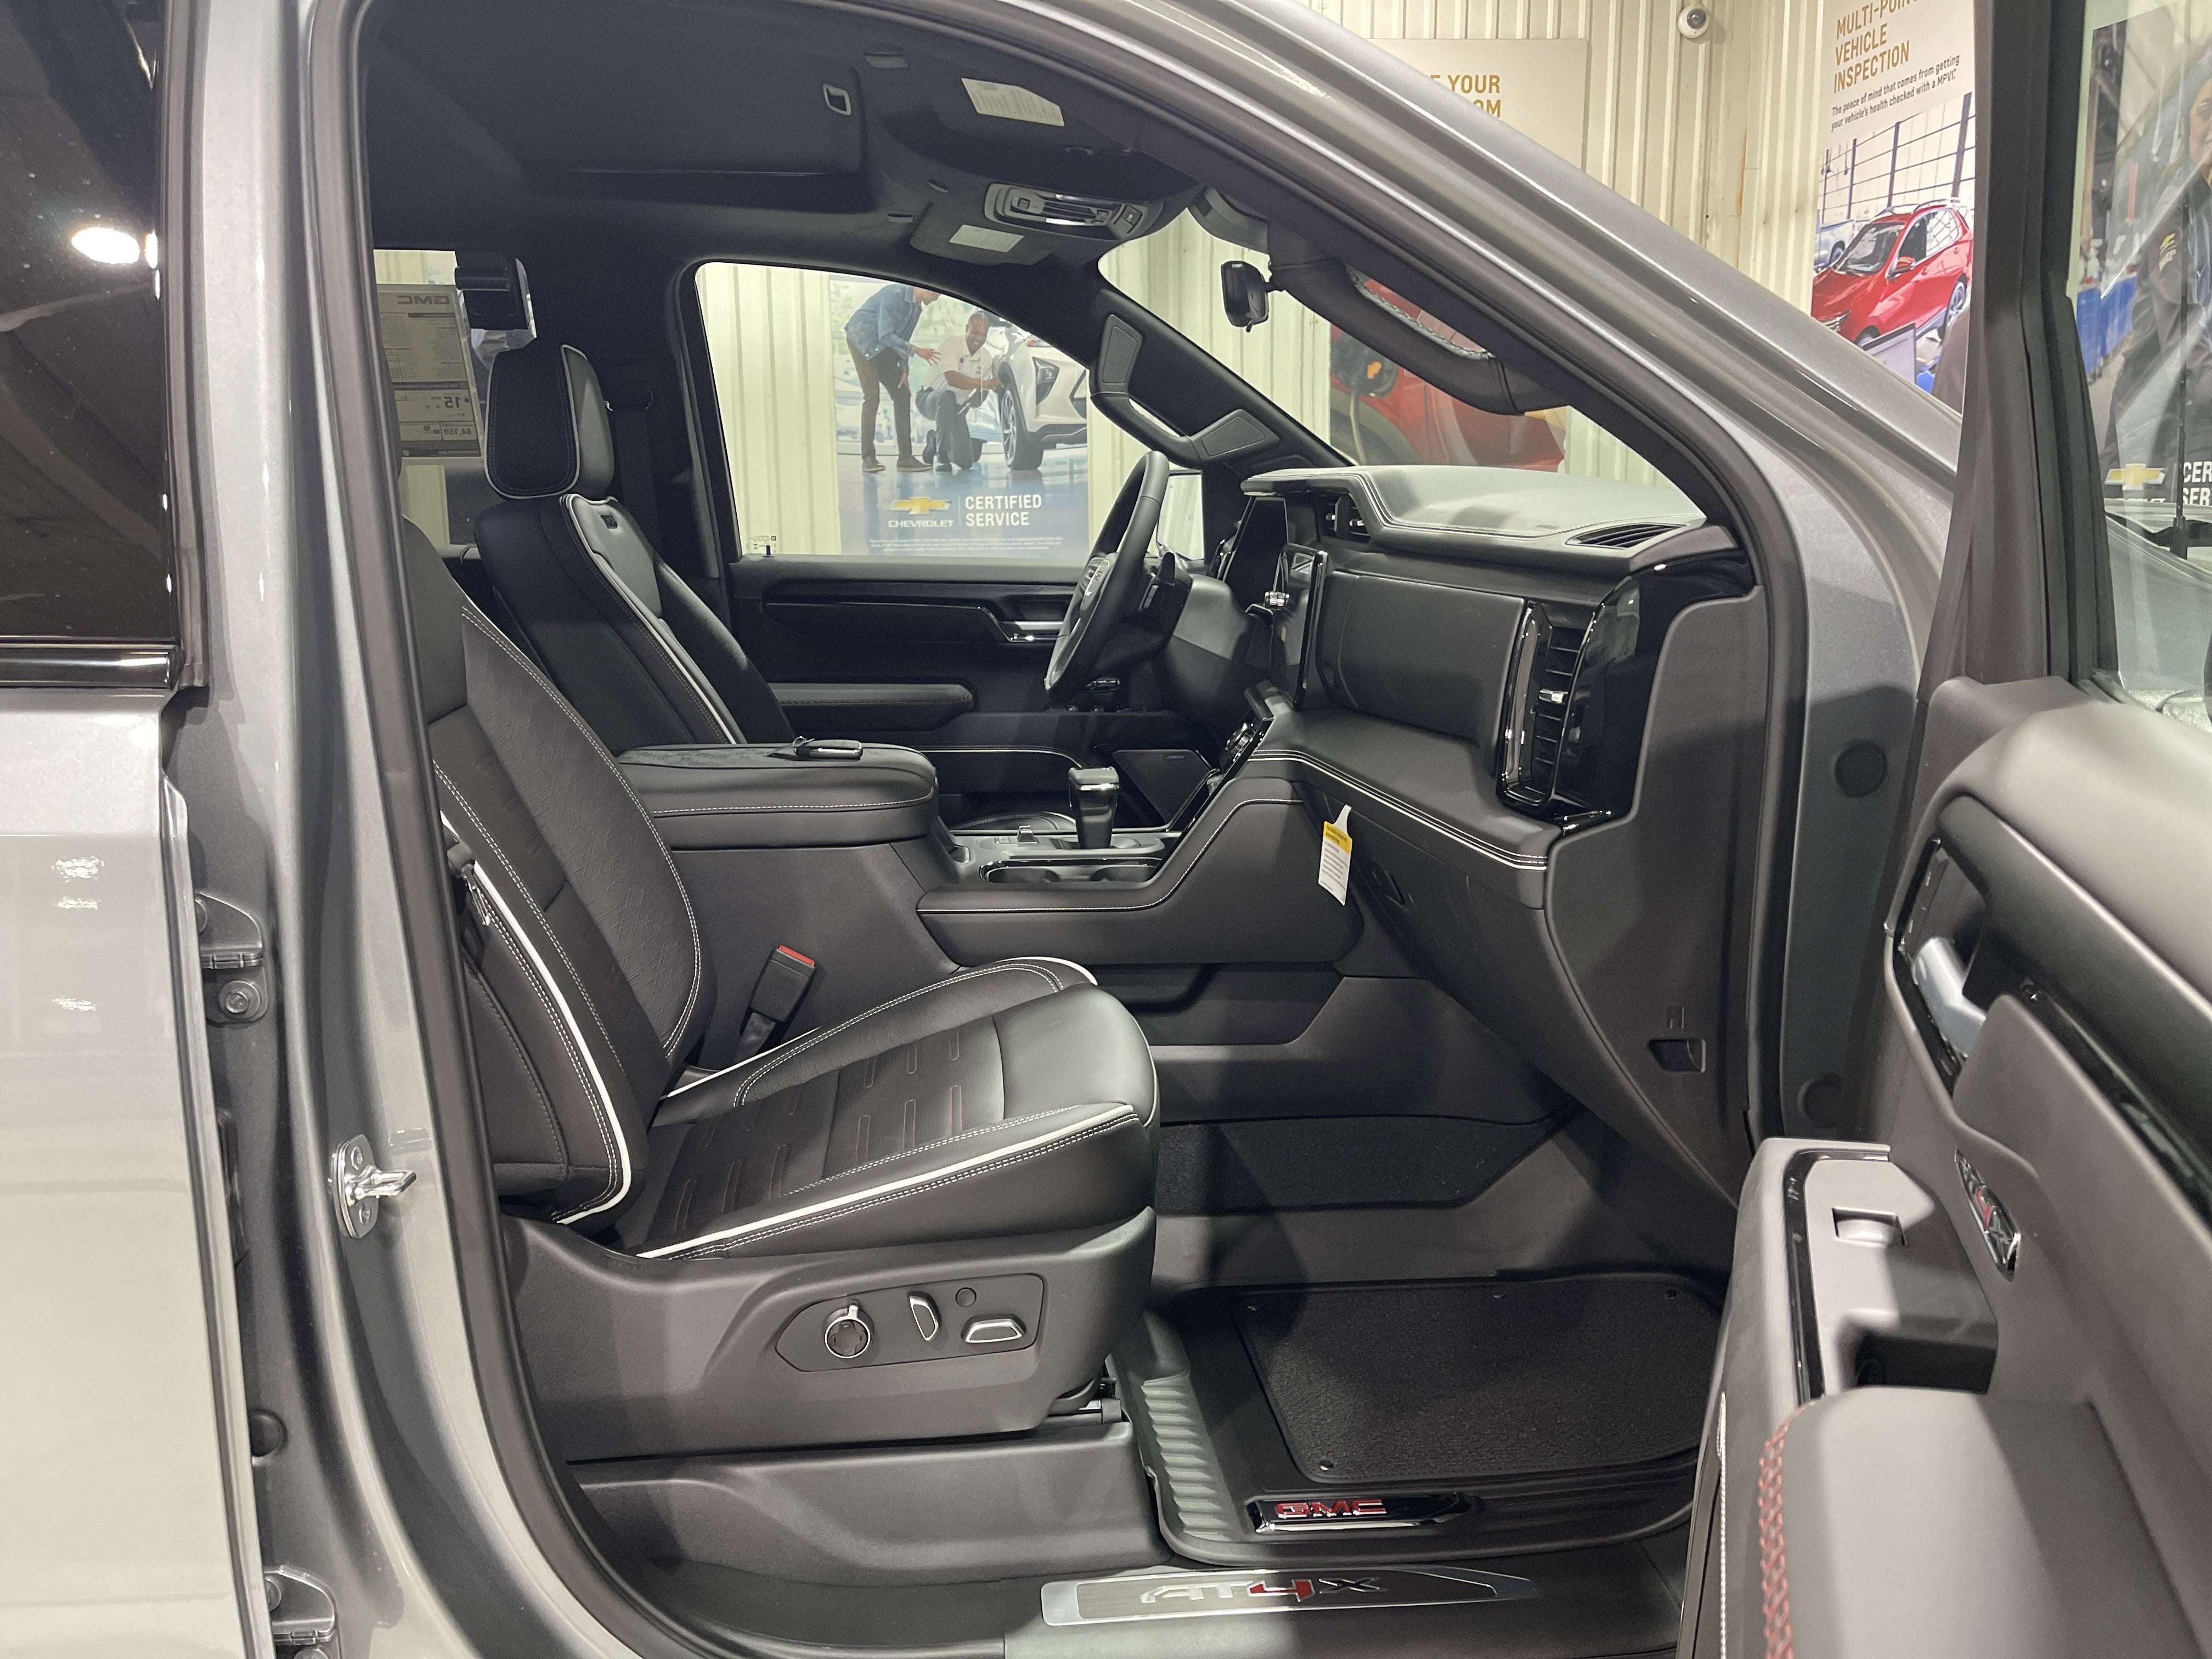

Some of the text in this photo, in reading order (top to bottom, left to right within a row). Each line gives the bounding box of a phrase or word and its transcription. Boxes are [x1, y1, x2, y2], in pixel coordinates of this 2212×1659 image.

[1836, 23, 1887, 66] VEHICLE
[1834, 41, 1910, 93] INSPECTION
[1447, 75, 1500, 93] YOUR
[1832, 55, 1960, 116] The peace of mind that comes from getting
[1831, 119, 1844, 132] your
[1870, 98, 1888, 114] health
[1889, 87, 1915, 106] checked
[1916, 80, 1930, 94] with
[1932, 80, 1936, 88] a
[965, 494, 1042, 510] CERTIFIED
[966, 512, 1029, 527] SERVICE
[1274, 1499, 1387, 1519] GMC
[1139, 1576, 1388, 1604] AT4X
